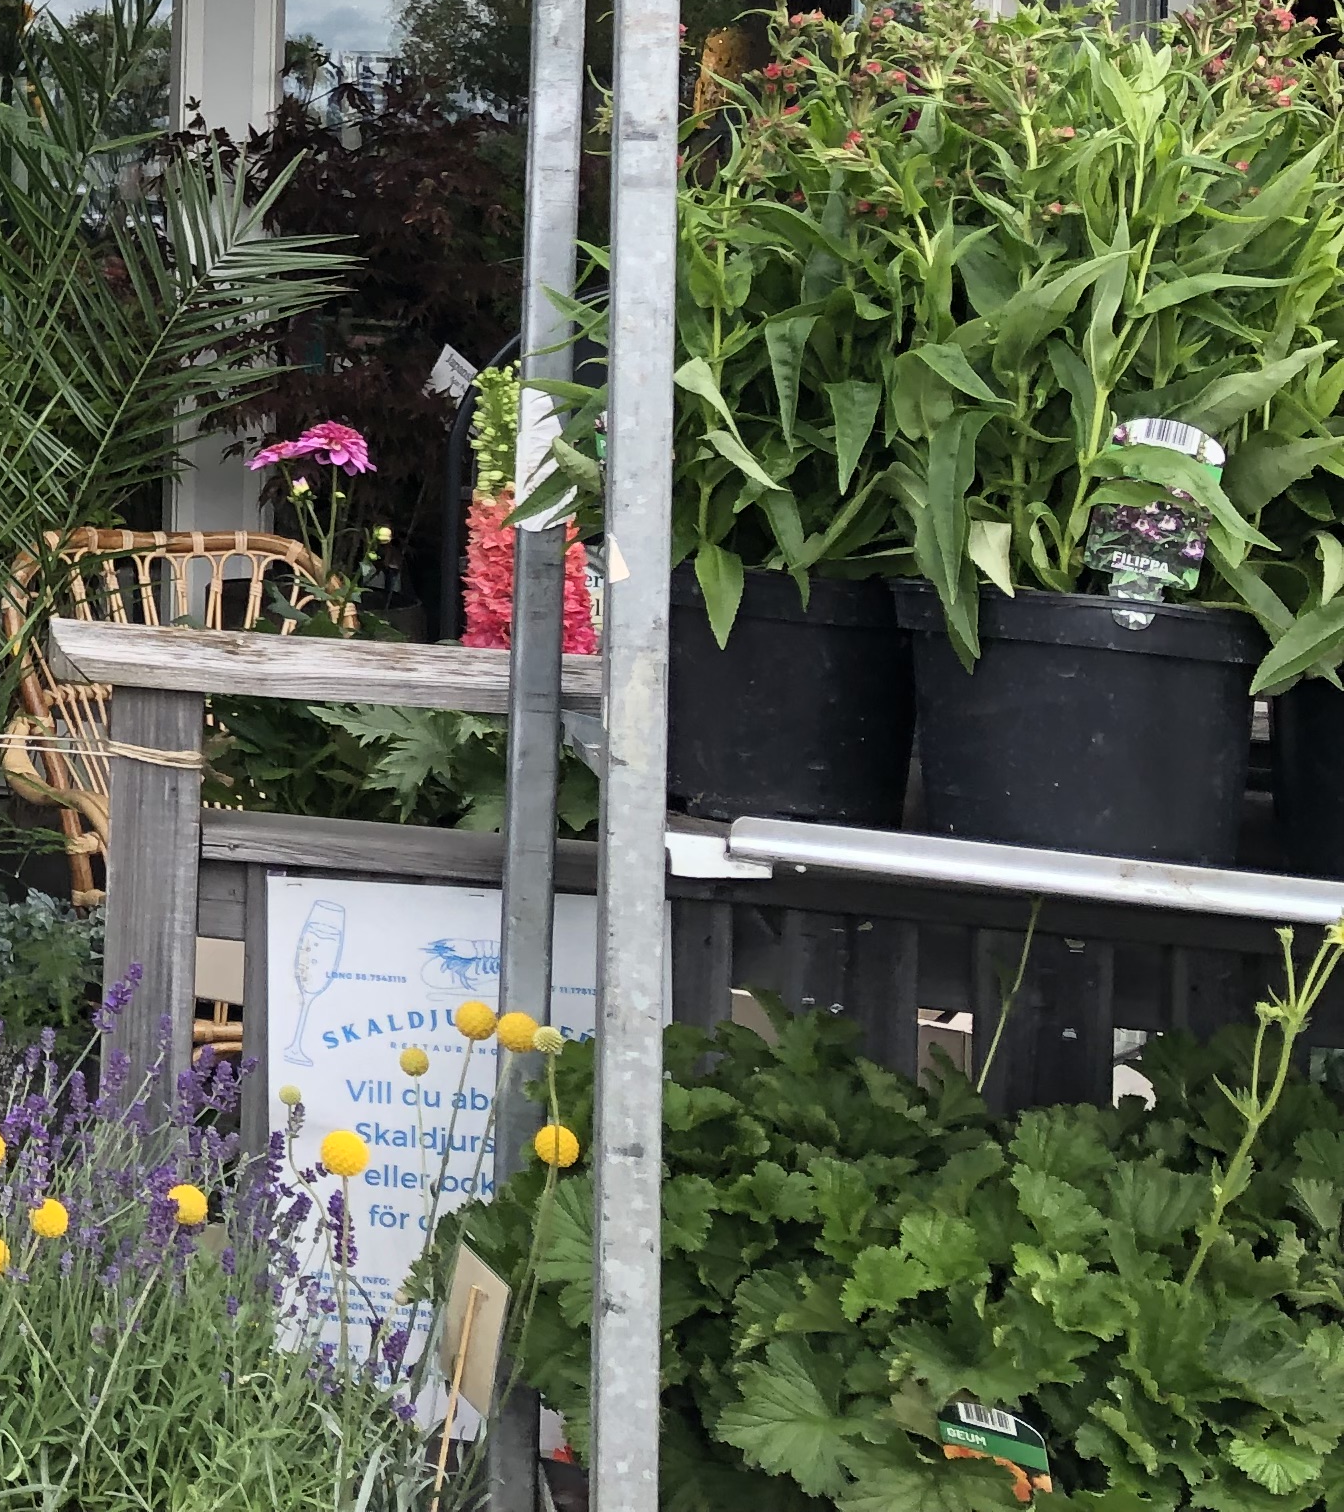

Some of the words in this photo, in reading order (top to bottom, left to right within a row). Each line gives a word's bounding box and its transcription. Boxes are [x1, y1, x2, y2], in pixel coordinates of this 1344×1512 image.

[1112, 550, 1169, 574] FILIPPA
[346, 1079, 392, 1105] Vill
[402, 1083, 441, 1108] du
[364, 1164, 431, 1190] eller
[369, 1204, 410, 1230] för
[946, 1427, 987, 1447] GEUM
